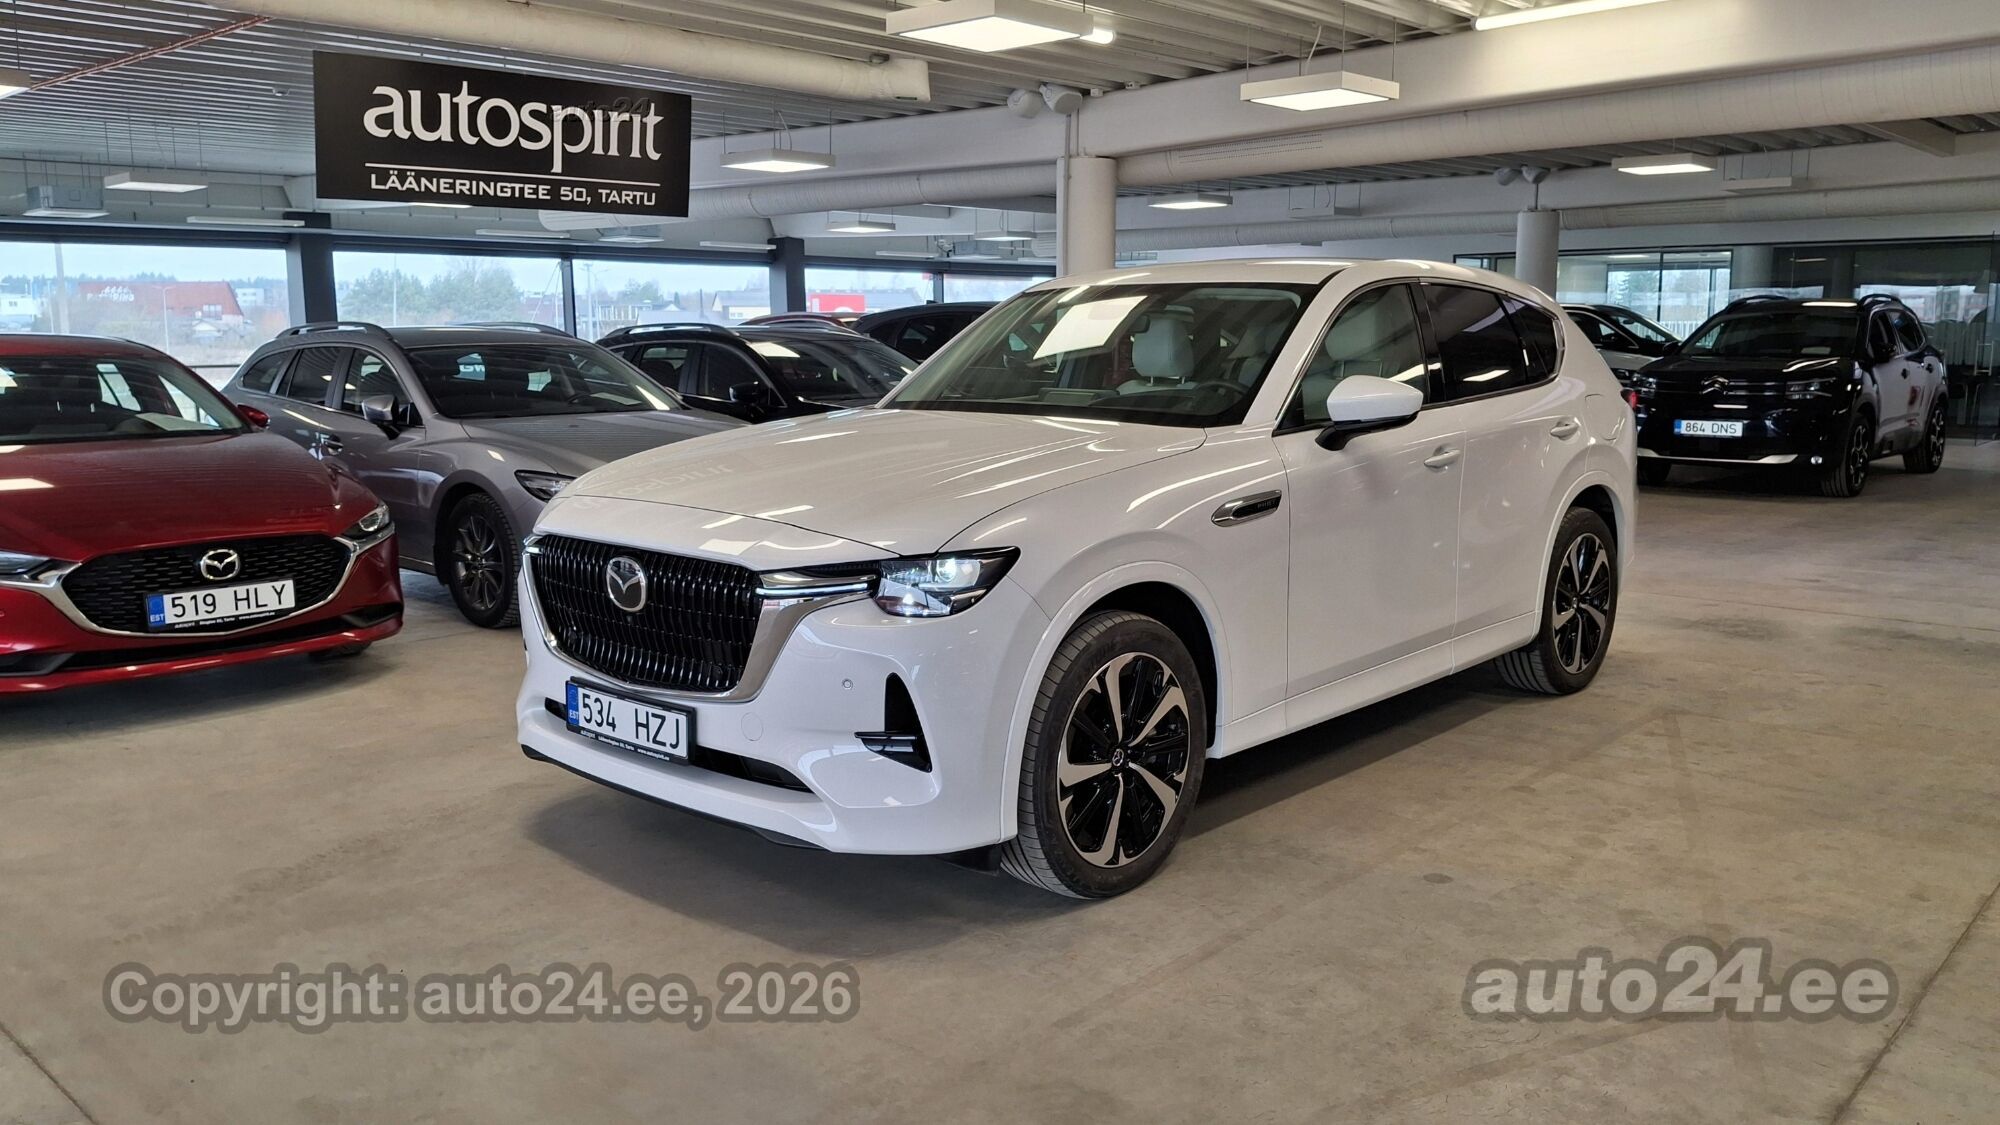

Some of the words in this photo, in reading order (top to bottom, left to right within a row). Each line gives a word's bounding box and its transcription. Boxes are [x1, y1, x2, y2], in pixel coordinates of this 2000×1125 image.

[363, 80, 665, 174] autospirit
[370, 170, 552, 201] LÄÄNERINGTEE
[559, 186, 592, 205] 50,
[597, 188, 657, 206] TARTU
[1685, 422, 1706, 433] 864
[1711, 423, 1737, 435] DNS
[150, 613, 165, 622] EST
[171, 593, 217, 618] 519
[233, 583, 286, 612] HLY
[568, 709, 580, 720] EST
[582, 693, 617, 732] 534
[634, 708, 680, 750] HZJ
